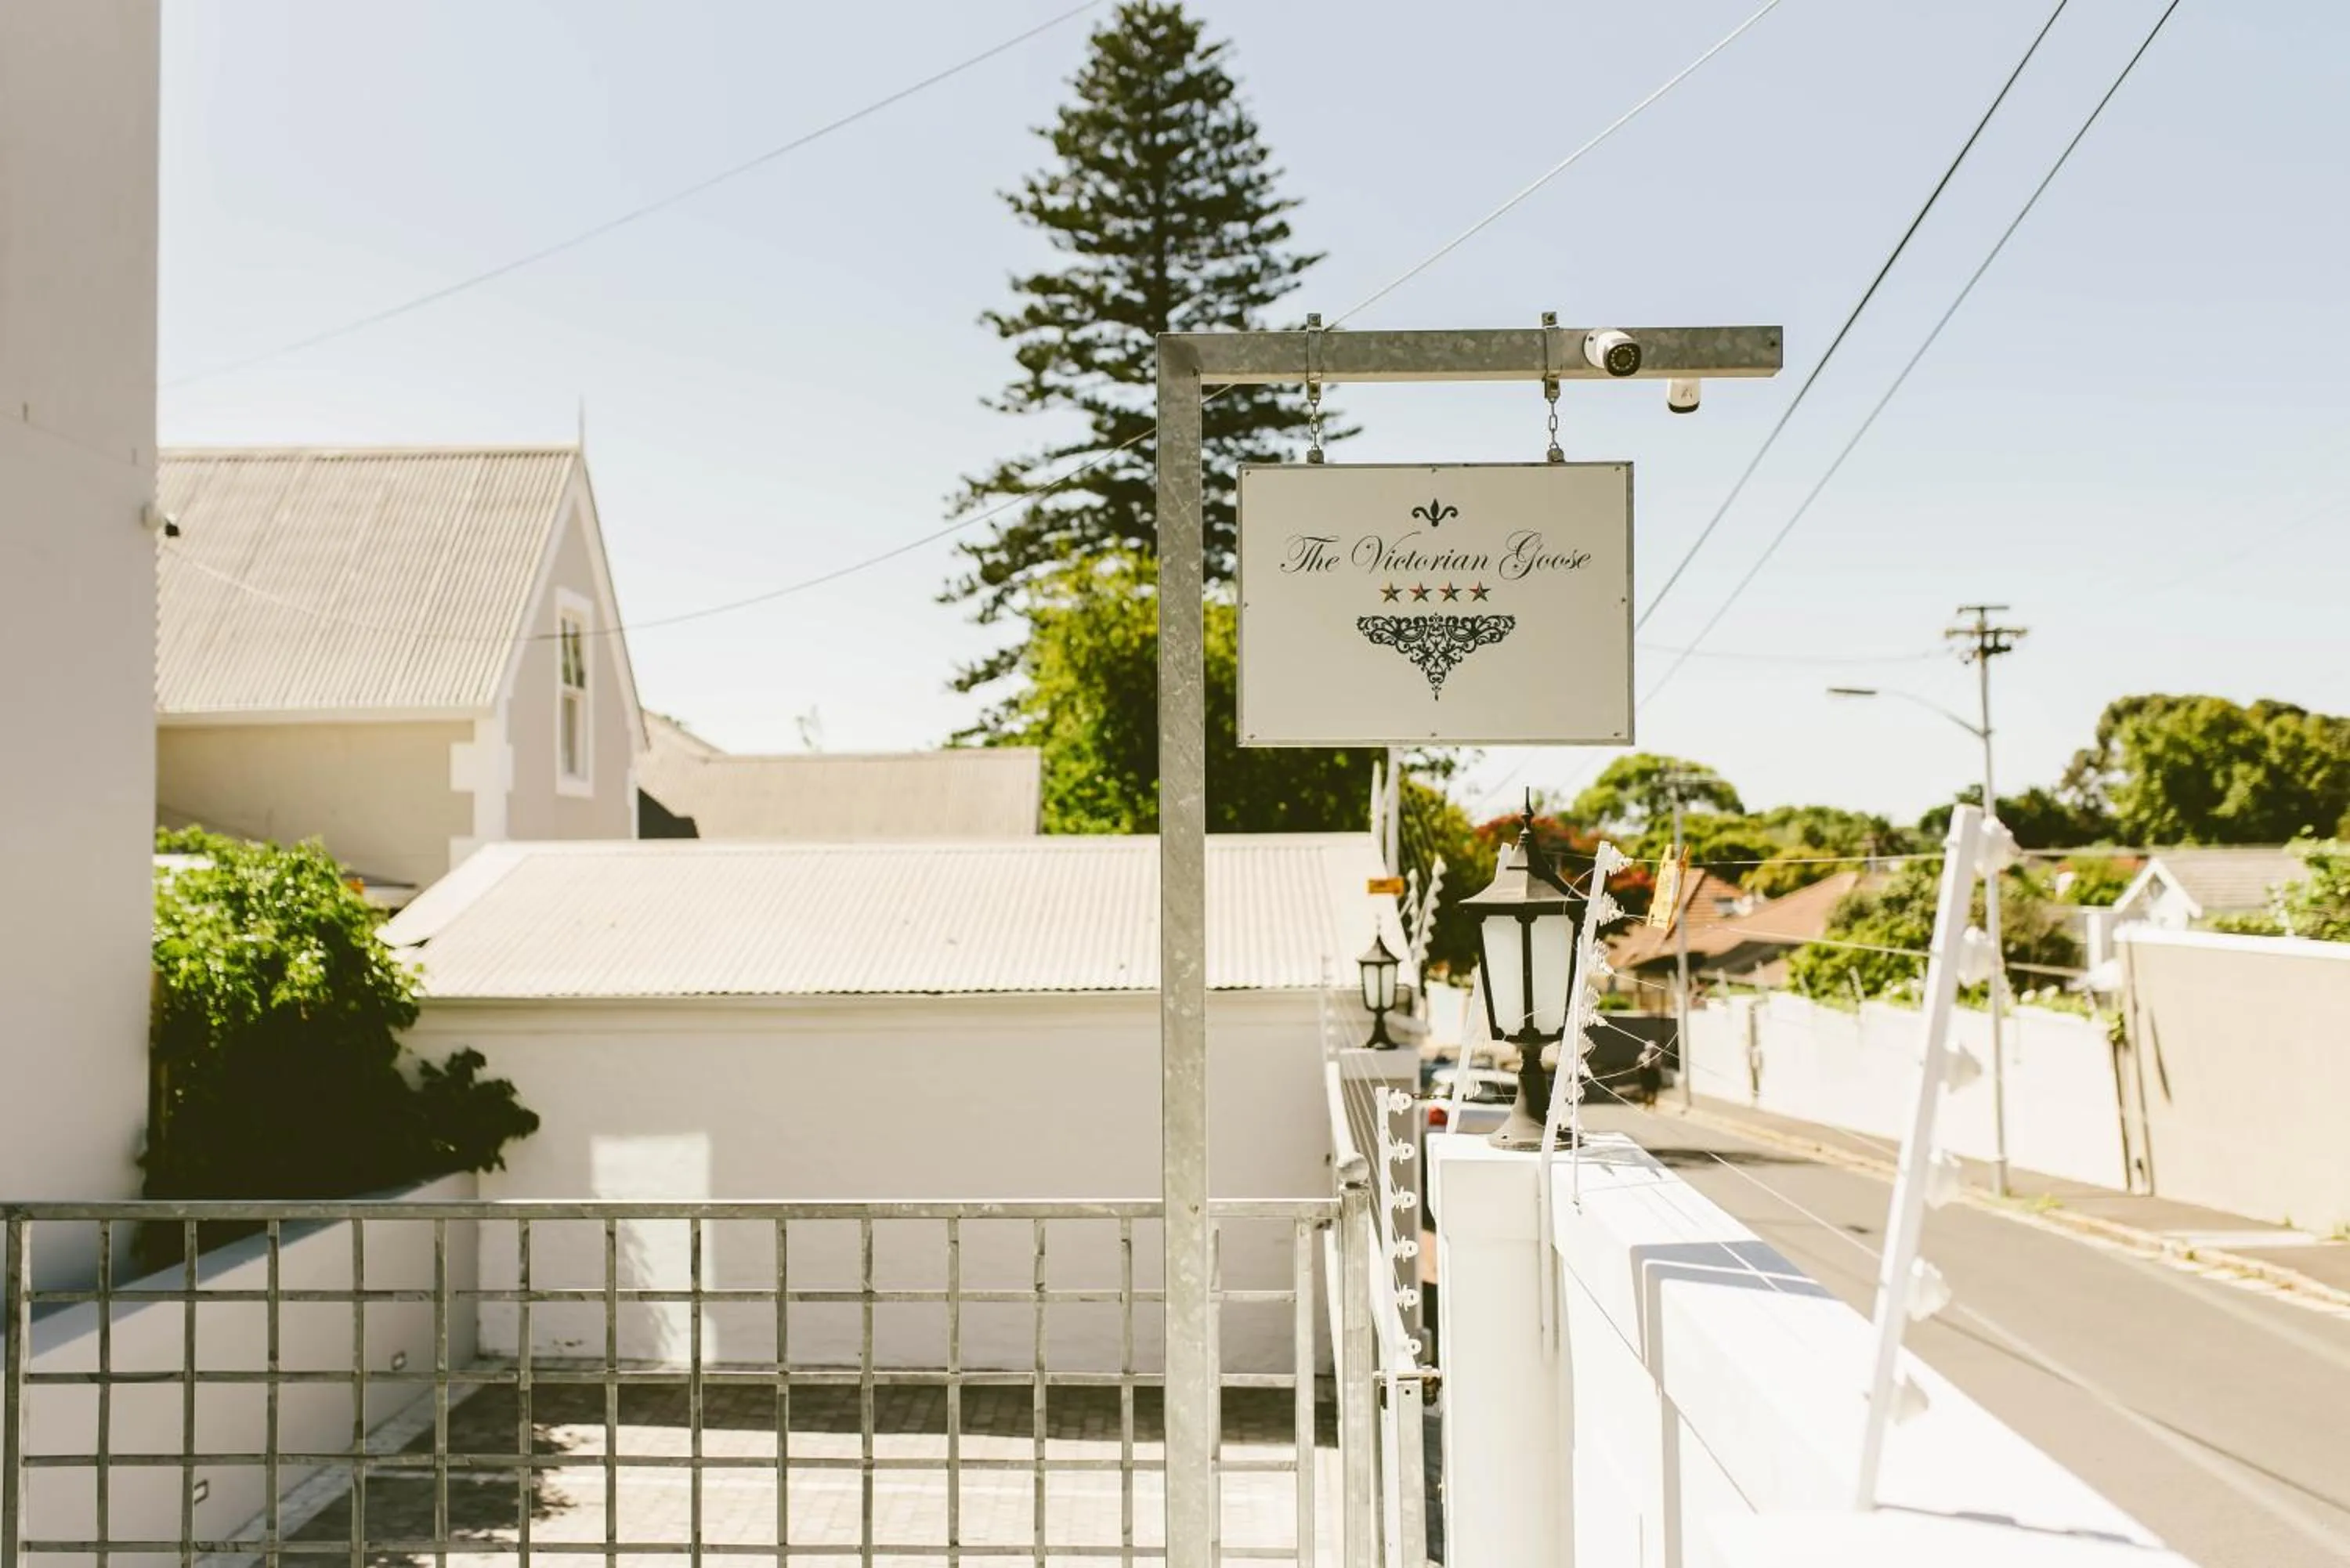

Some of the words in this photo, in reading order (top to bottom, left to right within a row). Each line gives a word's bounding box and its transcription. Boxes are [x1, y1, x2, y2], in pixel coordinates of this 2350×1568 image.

[1280, 534, 1340, 573] The
[1351, 531, 1490, 574] Victorian
[1499, 529, 1591, 580] Goose
